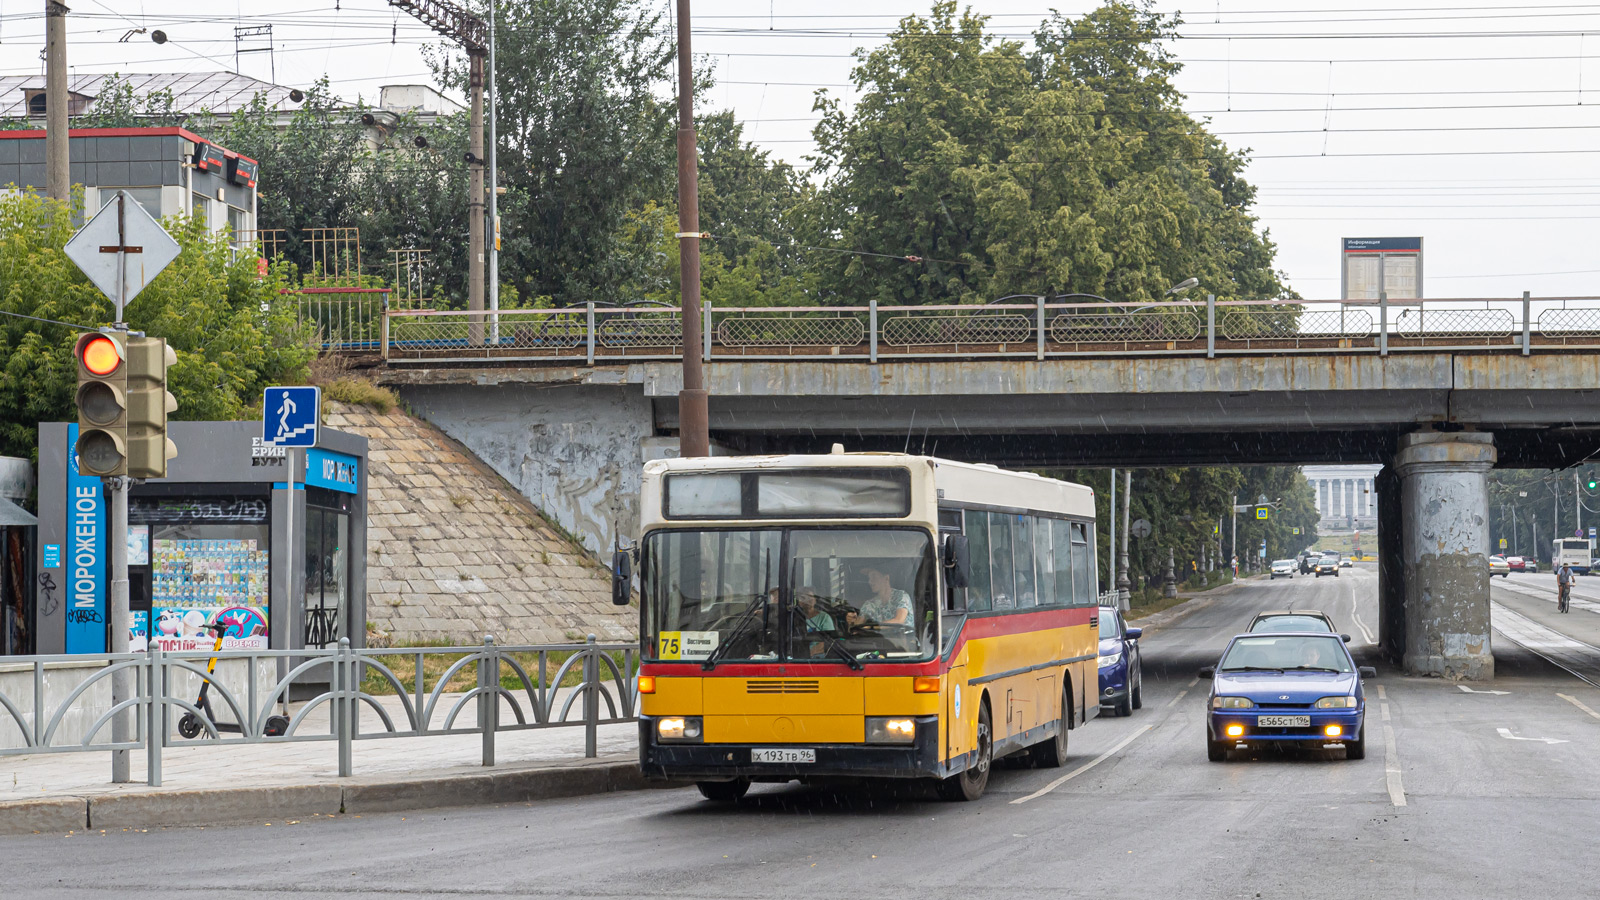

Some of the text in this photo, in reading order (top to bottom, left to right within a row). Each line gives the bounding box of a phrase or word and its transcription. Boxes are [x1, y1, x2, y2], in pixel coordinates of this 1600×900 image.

[203, 145, 209, 161] 2
[252, 448, 286, 457] ЕРИН
[252, 457, 286, 466] БУРГ
[75, 486, 96, 607] МОРОЖЕНОЕ
[226, 640, 260, 648] ВРЕМЯ
[661, 638, 679, 654] 75
